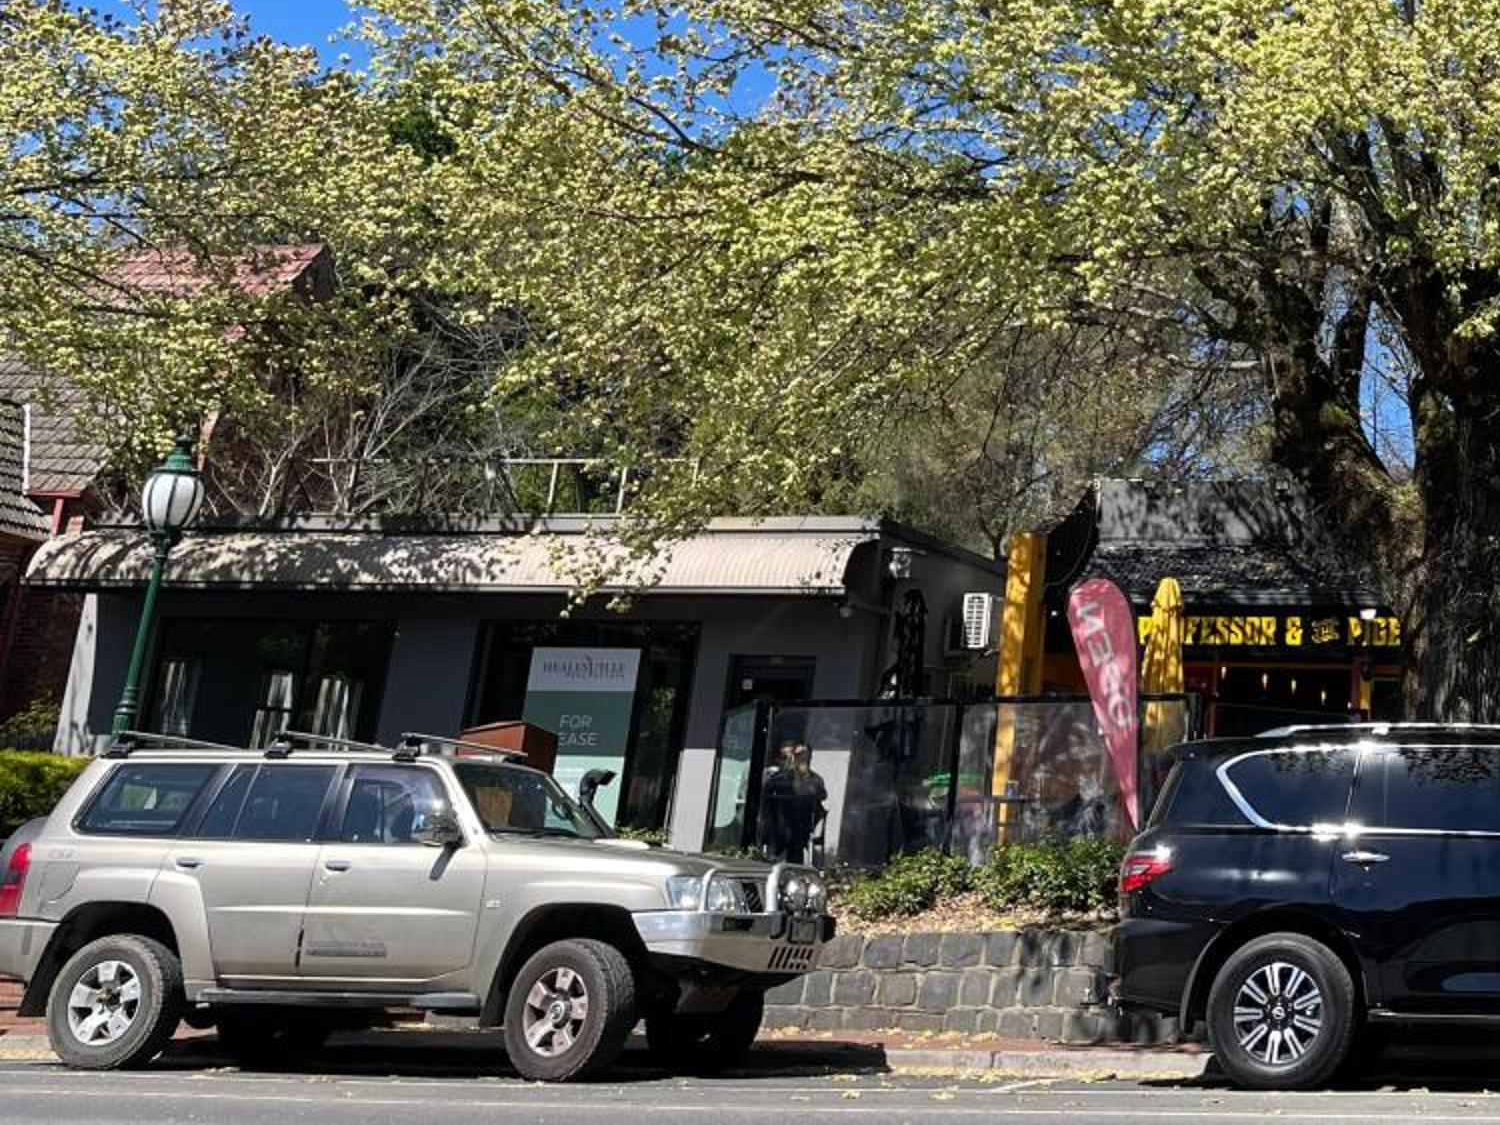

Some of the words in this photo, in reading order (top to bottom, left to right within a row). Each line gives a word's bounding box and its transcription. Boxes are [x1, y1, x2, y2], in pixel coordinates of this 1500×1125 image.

[1137, 616, 1277, 645] PFESSOR
[1285, 617, 1302, 645] &
[1076, 603, 1132, 727] OPEN
[559, 715, 593, 728] FOR
[557, 732, 599, 746] EASE
